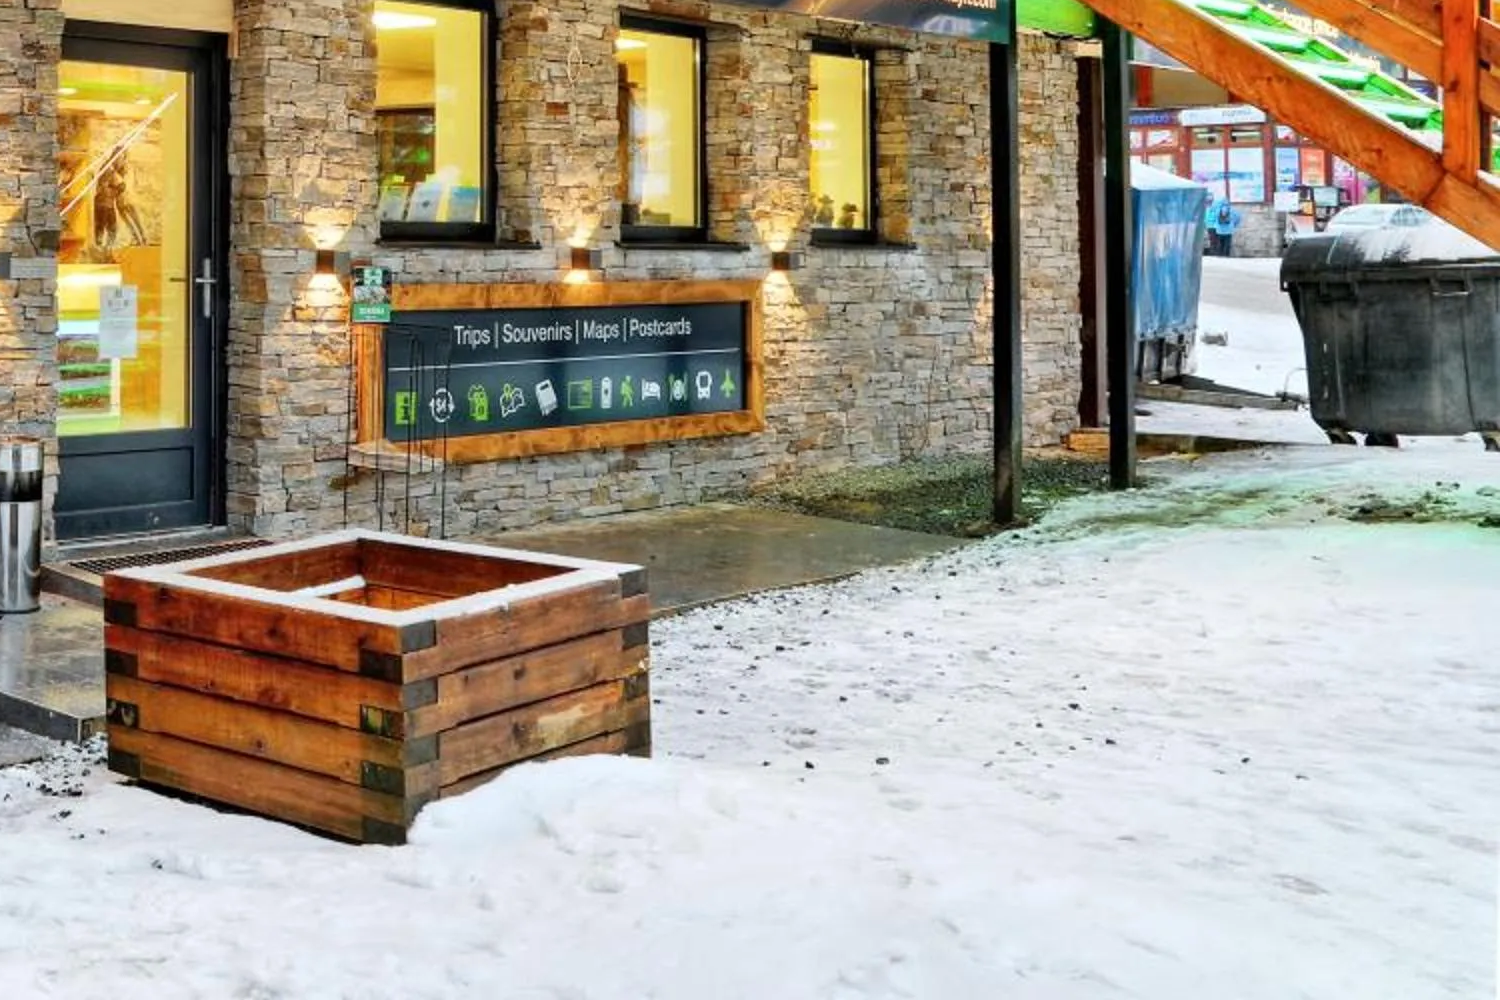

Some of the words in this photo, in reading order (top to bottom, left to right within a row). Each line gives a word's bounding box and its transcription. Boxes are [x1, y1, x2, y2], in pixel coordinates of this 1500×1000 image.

[454, 325, 490, 349] Trips
[503, 322, 572, 343] Souvenirs
[583, 320, 619, 342] Maps
[630, 318, 691, 337] Postcards
